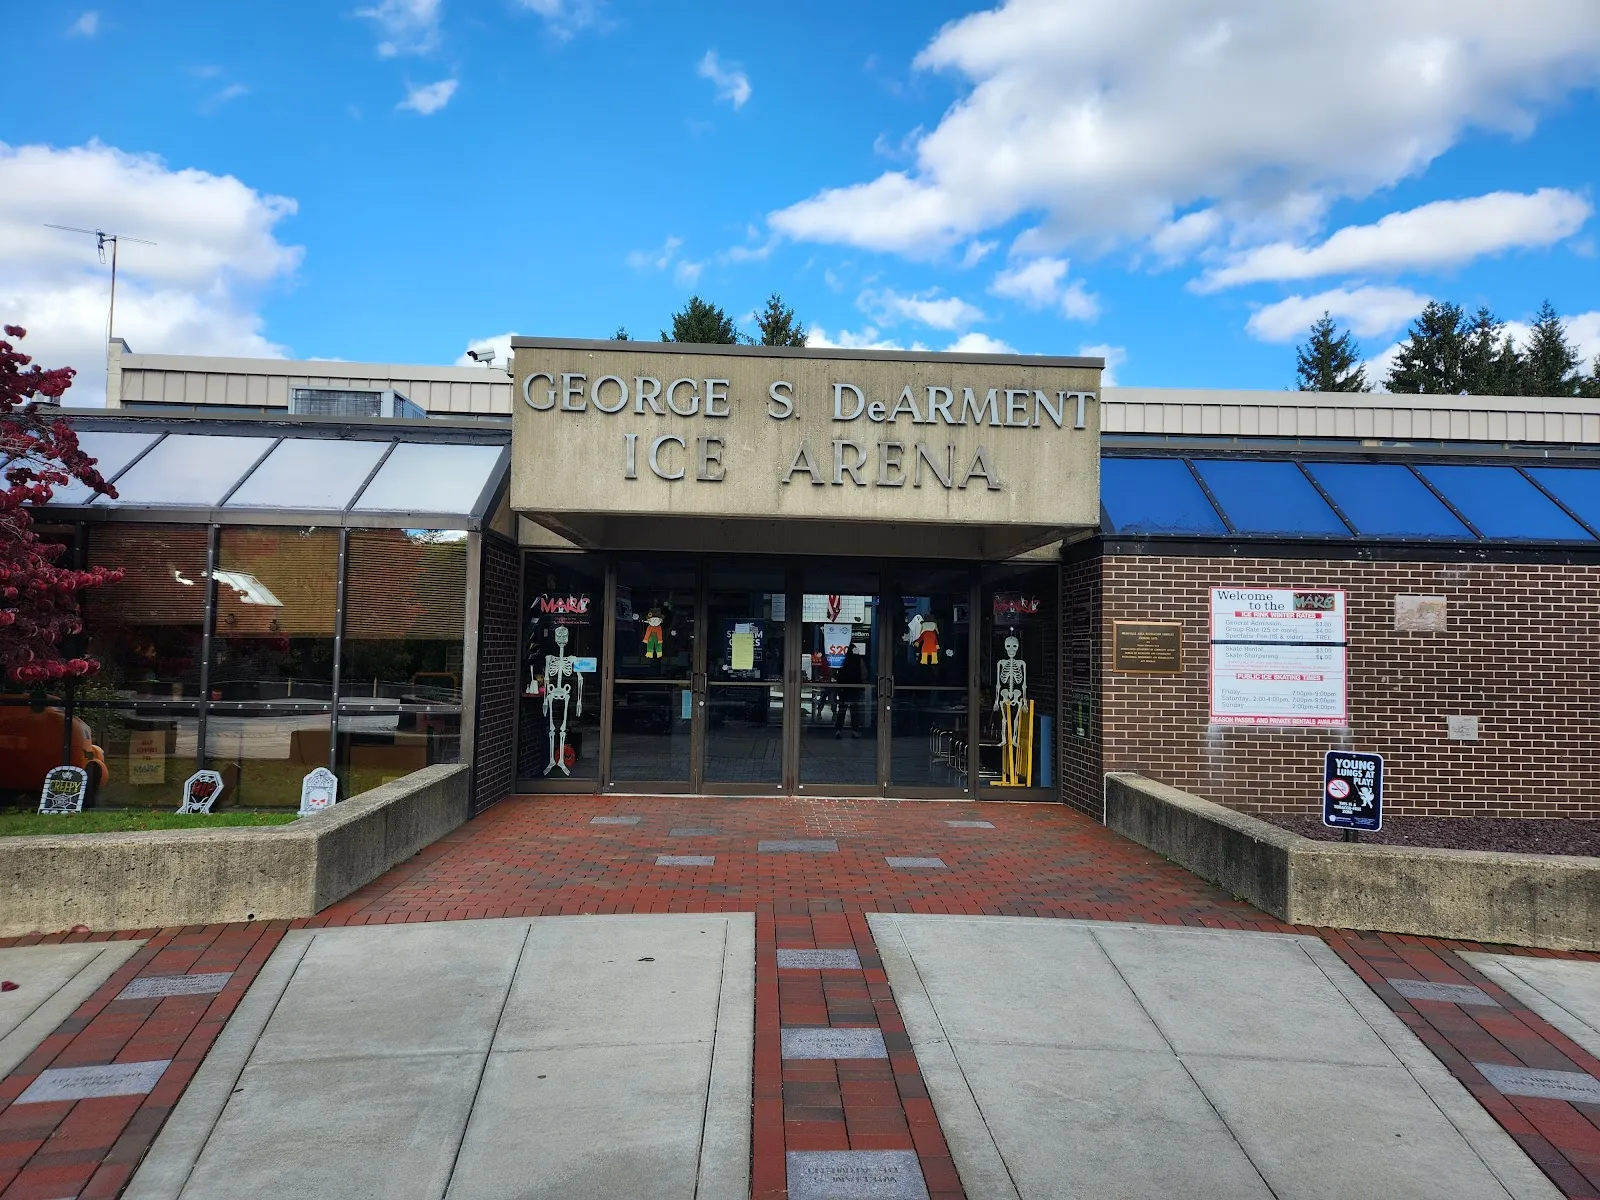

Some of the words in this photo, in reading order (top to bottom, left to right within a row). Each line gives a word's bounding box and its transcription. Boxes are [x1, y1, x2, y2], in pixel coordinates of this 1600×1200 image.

[522, 371, 730, 418] GEORGE
[768, 380, 800, 419] S.
[832, 382, 1096, 429] DeARMENT
[624, 433, 727, 481] ICE
[781, 439, 1000, 490] ARENA
[1217, 590, 1273, 600] Welcome
[1249, 602, 1261, 610] to
[1264, 602, 1285, 610] the
[1334, 758, 1376, 770] YOUNG
[1336, 768, 1362, 777] LUNGS
[1365, 770, 1375, 778] AT
[50, 779, 82, 793] CREEPY
[192, 780, 216, 796] RIP
[1354, 778, 1374, 786] PLAY!
